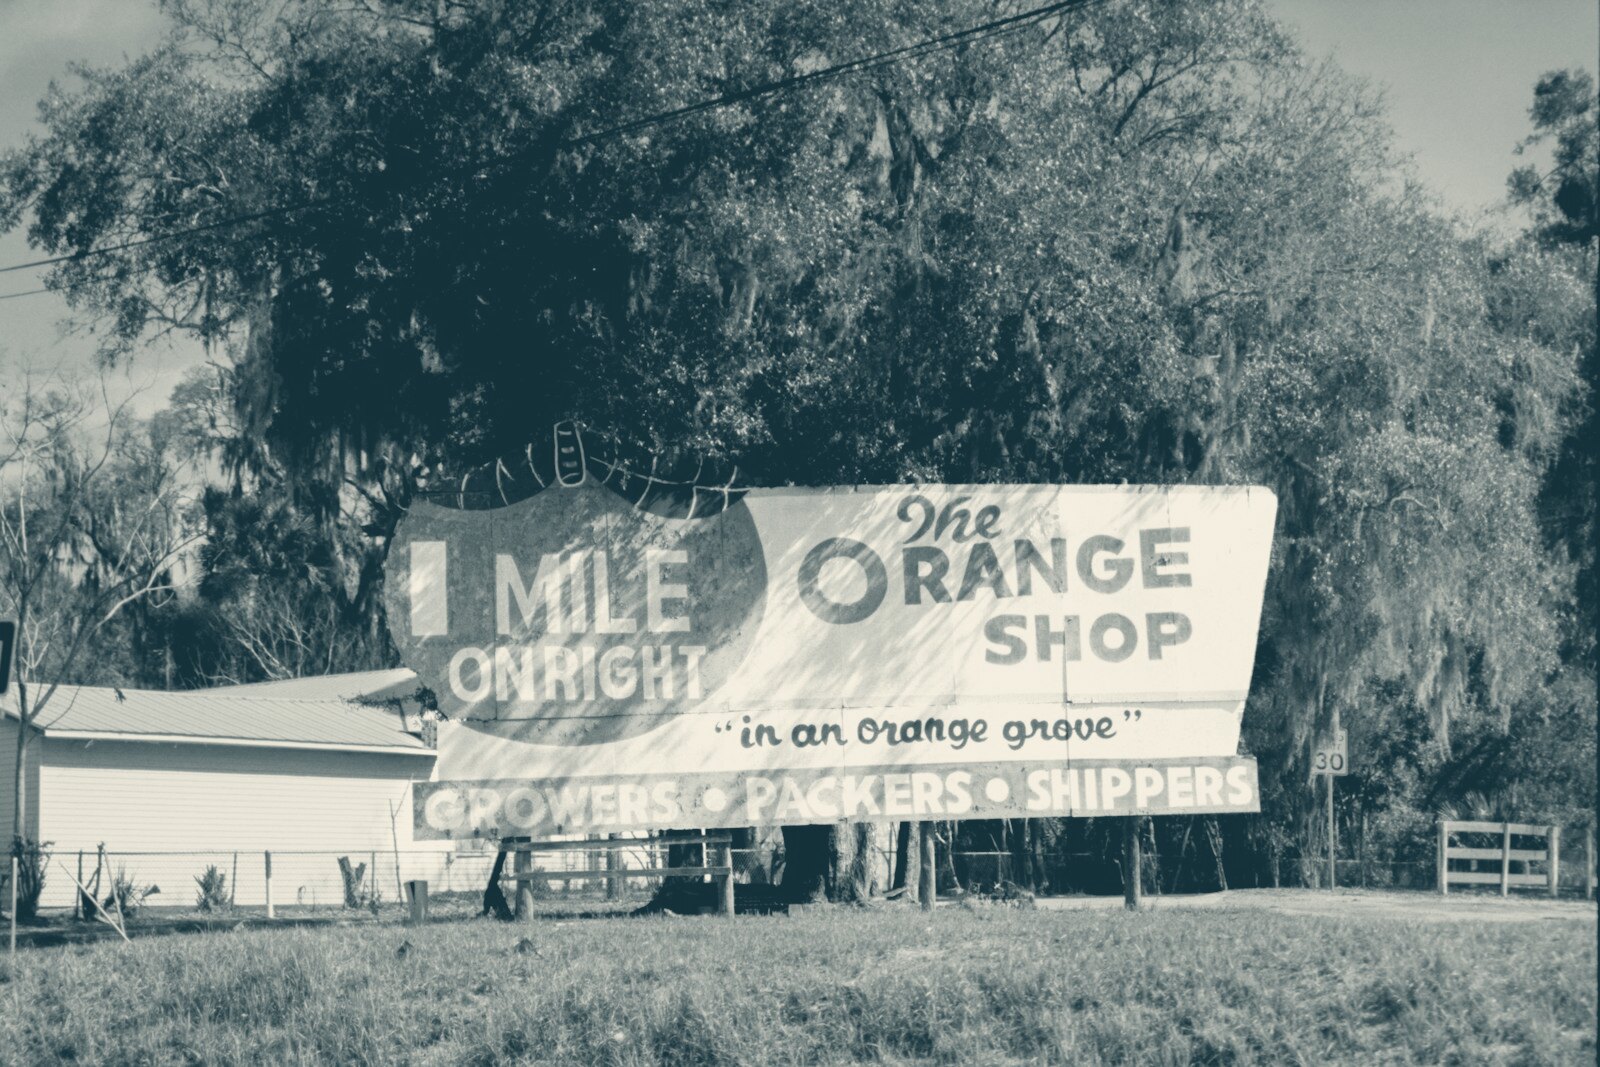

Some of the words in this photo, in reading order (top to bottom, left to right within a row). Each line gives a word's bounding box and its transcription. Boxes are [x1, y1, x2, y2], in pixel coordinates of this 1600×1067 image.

[896, 494, 1002, 545] The
[496, 549, 691, 635] MILE
[797, 526, 1193, 625] ORANGE
[984, 612, 1193, 666] SHOP
[790, 719, 848, 748] an
[856, 716, 988, 750] orange
[1315, 752, 1344, 771] 30
[424, 780, 680, 830] GROWERS
[745, 772, 973, 822] PACKERS
[1026, 765, 1253, 813] SHIPPERS
